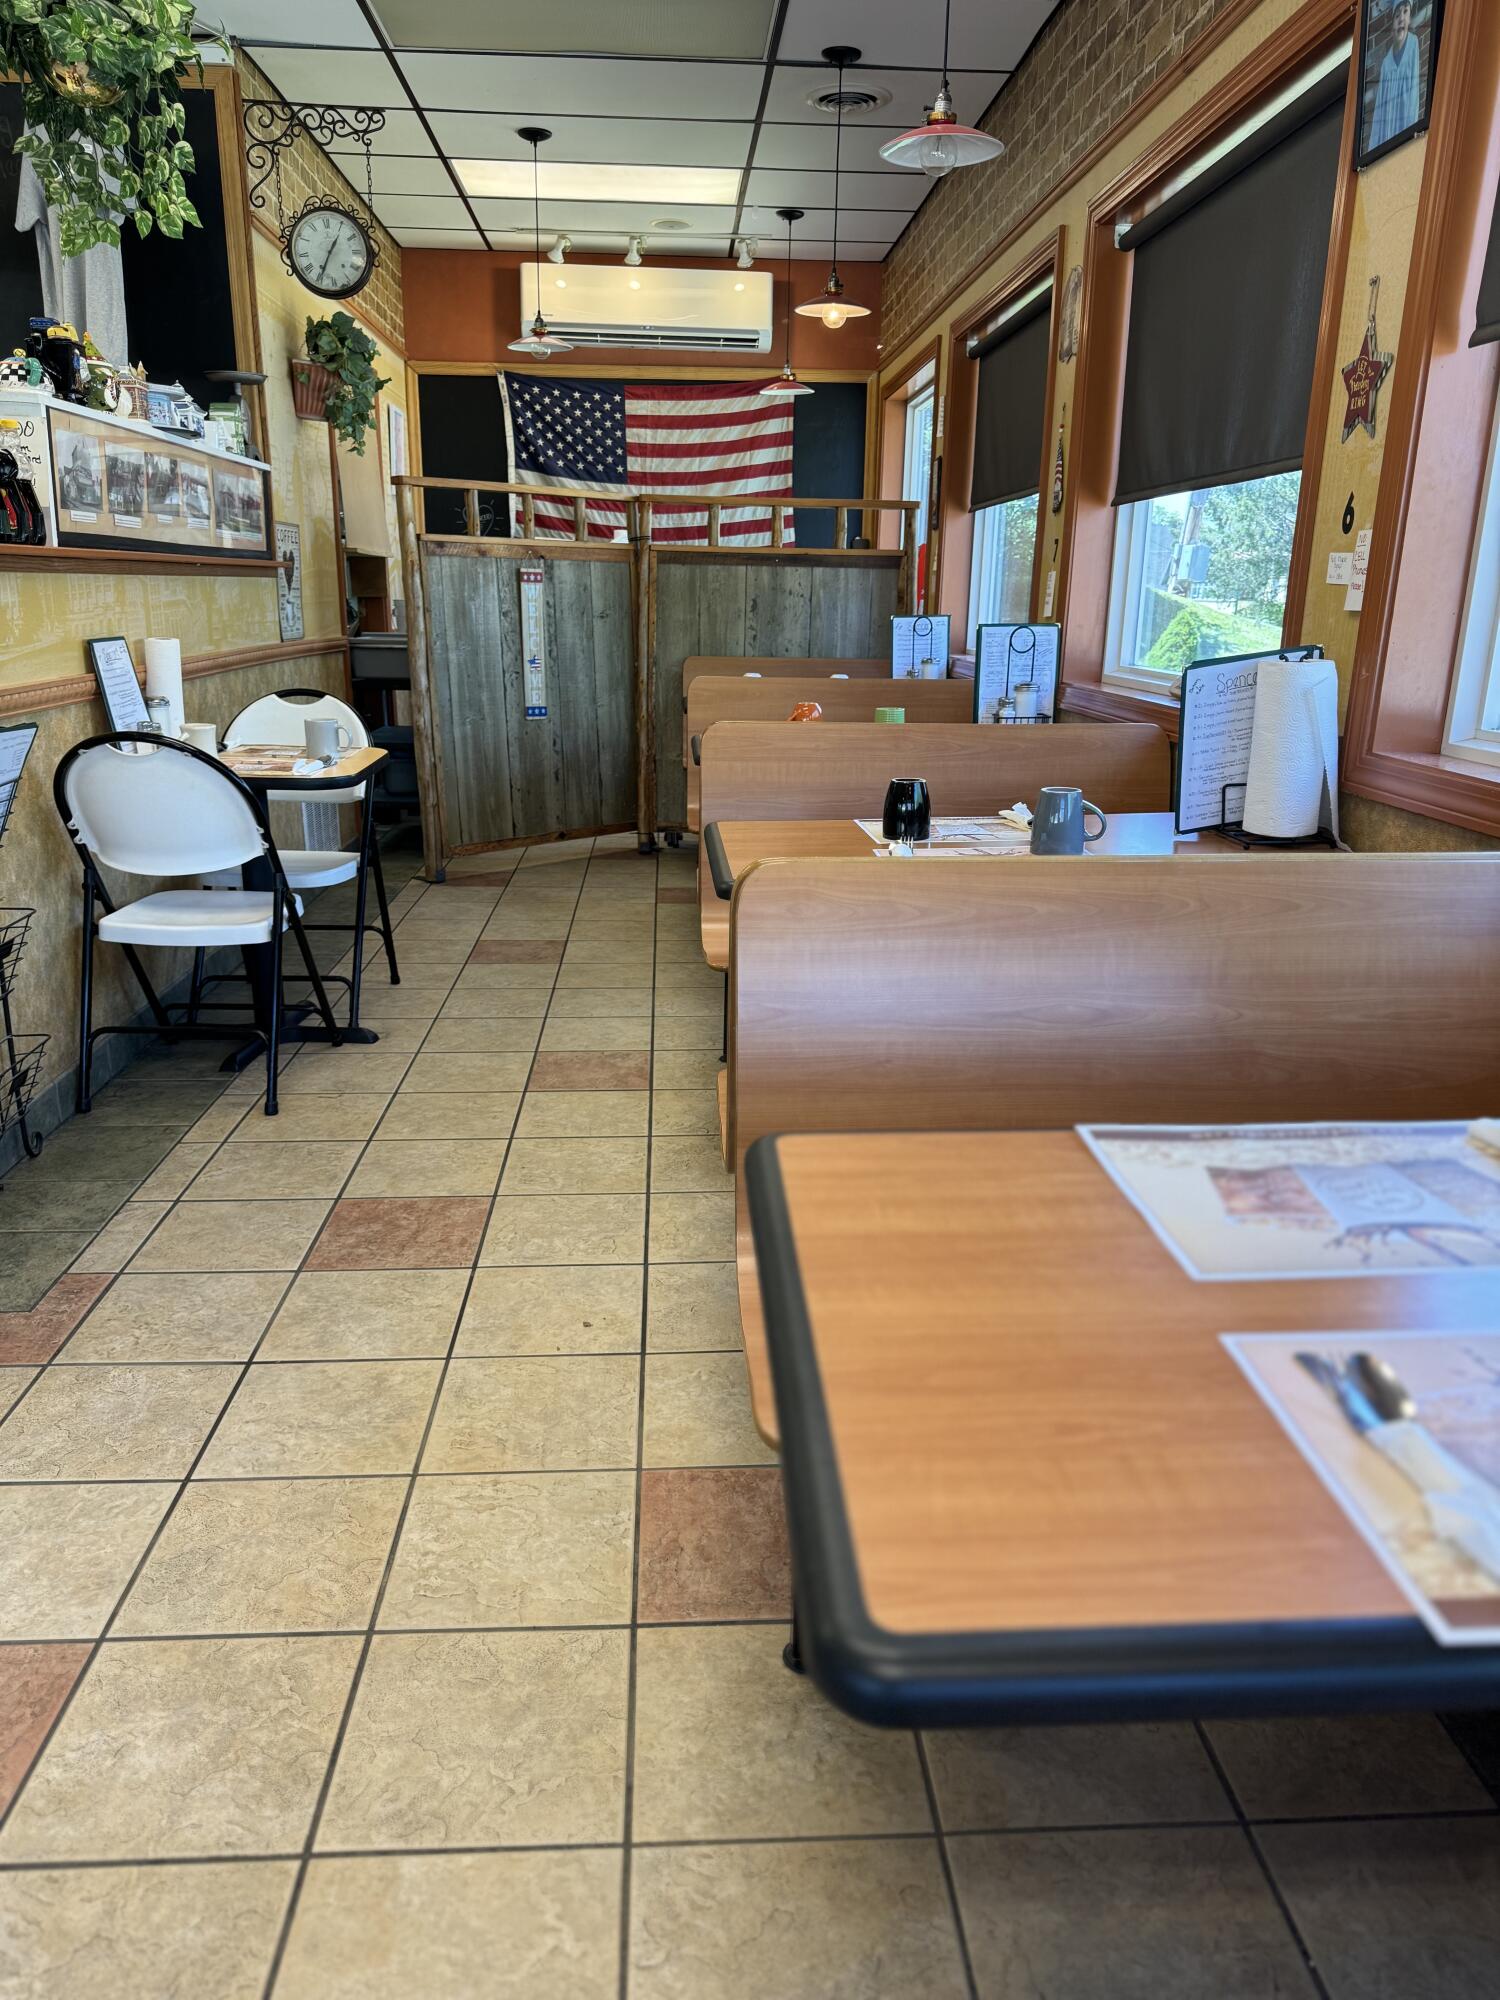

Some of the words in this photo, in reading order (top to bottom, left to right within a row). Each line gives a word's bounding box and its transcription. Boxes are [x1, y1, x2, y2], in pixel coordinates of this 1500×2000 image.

[1342, 491, 1355, 535] 6
[276, 528, 299, 544] COFFEE
[1053, 538, 1060, 563] 7
